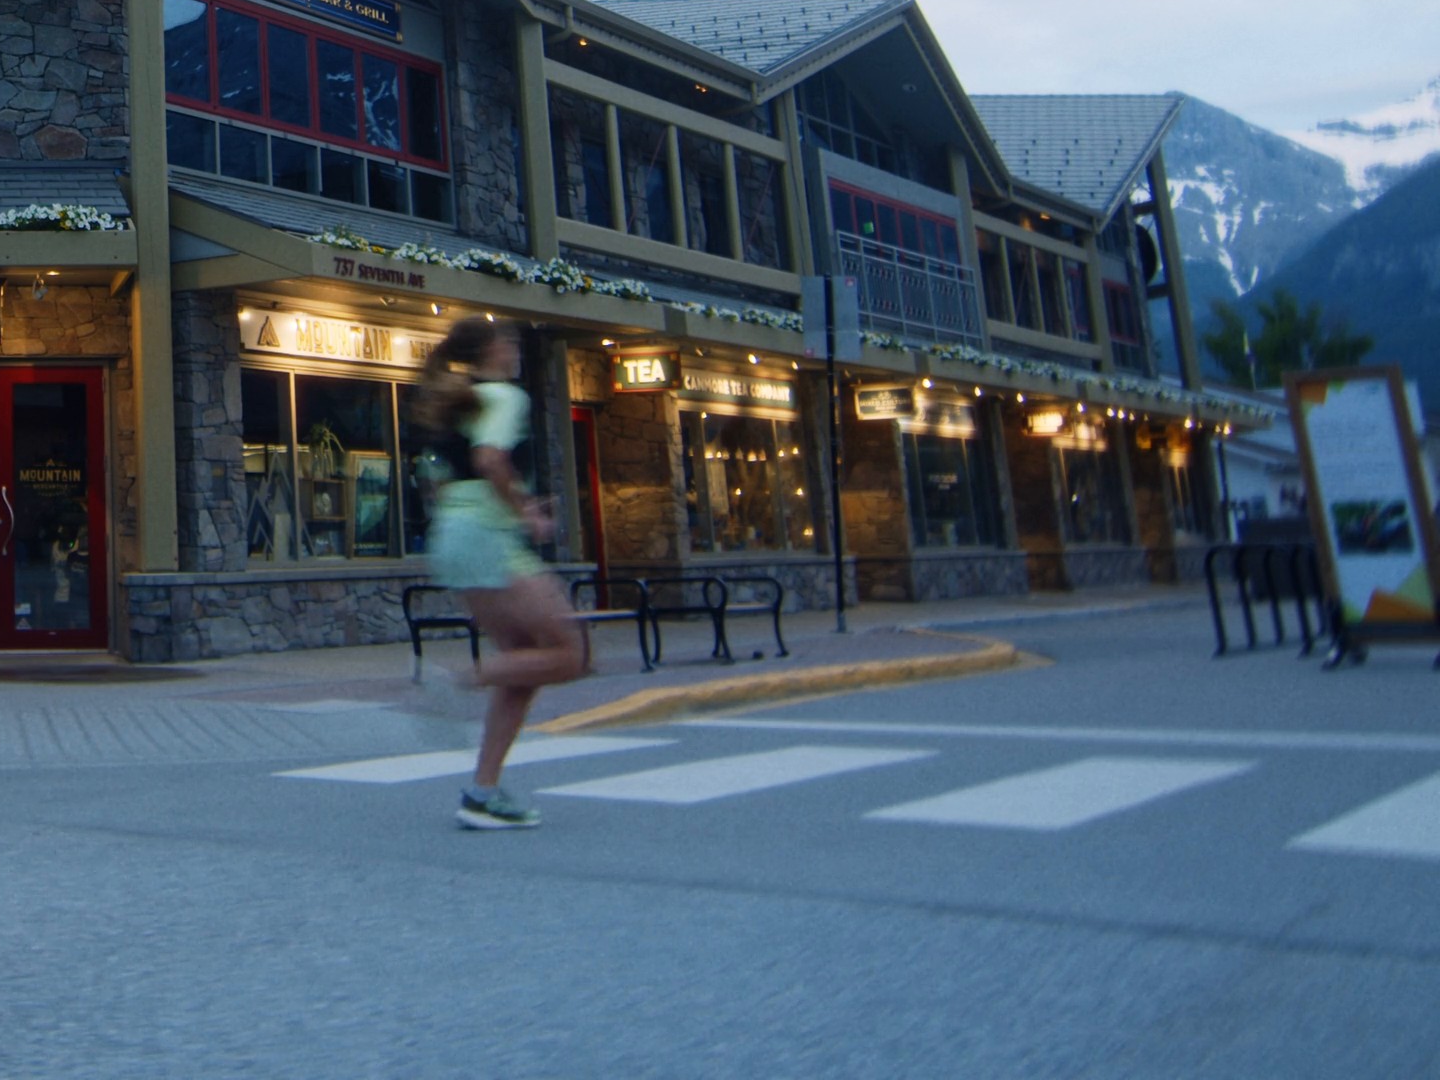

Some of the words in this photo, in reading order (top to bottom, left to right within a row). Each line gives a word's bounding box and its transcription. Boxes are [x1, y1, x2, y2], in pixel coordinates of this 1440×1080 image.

[344, 0, 353, 12] &
[356, 4, 390, 24] GRILL
[334, 256, 355, 277] 737
[358, 263, 406, 287] SEVENTH
[407, 272, 426, 289] AVE
[295, 318, 393, 361] MOUNTAIN
[623, 358, 666, 384] TEA
[683, 375, 730, 395] CANMORE
[730, 380, 749, 397] TEA
[750, 383, 791, 402] COMPANY
[19, 469, 81, 482] MOUNTAIN
